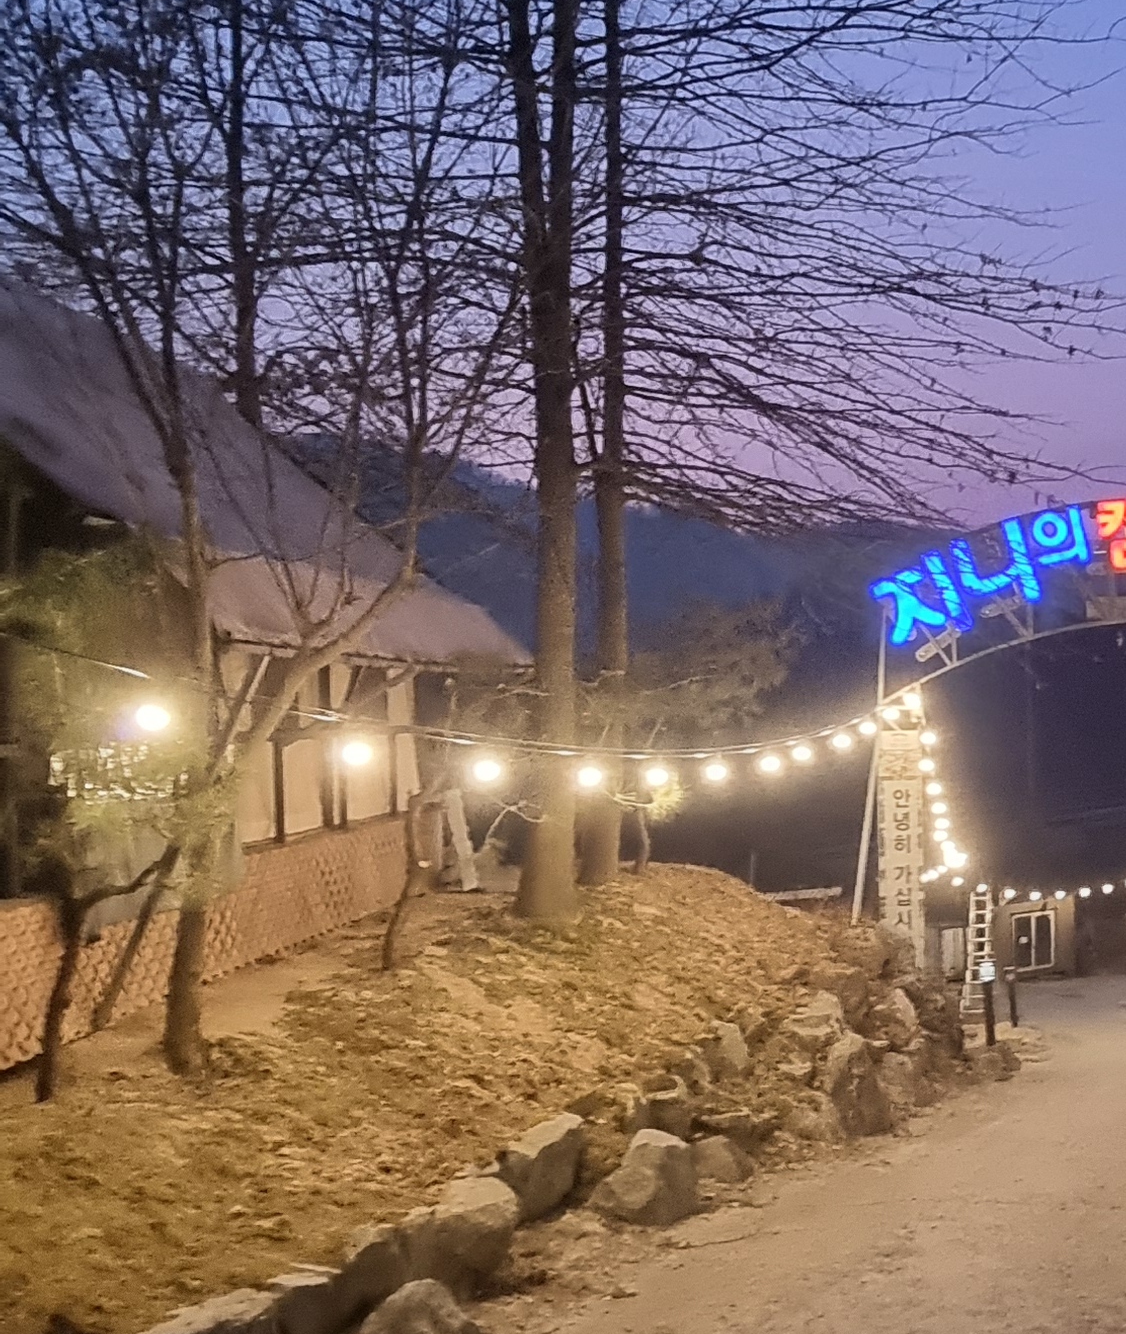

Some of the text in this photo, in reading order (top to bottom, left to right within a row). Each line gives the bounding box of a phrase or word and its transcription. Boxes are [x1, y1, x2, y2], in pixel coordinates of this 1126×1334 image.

[869, 504, 1090, 646] 지니의
[893, 789, 912, 930] 안녕히 가십시
